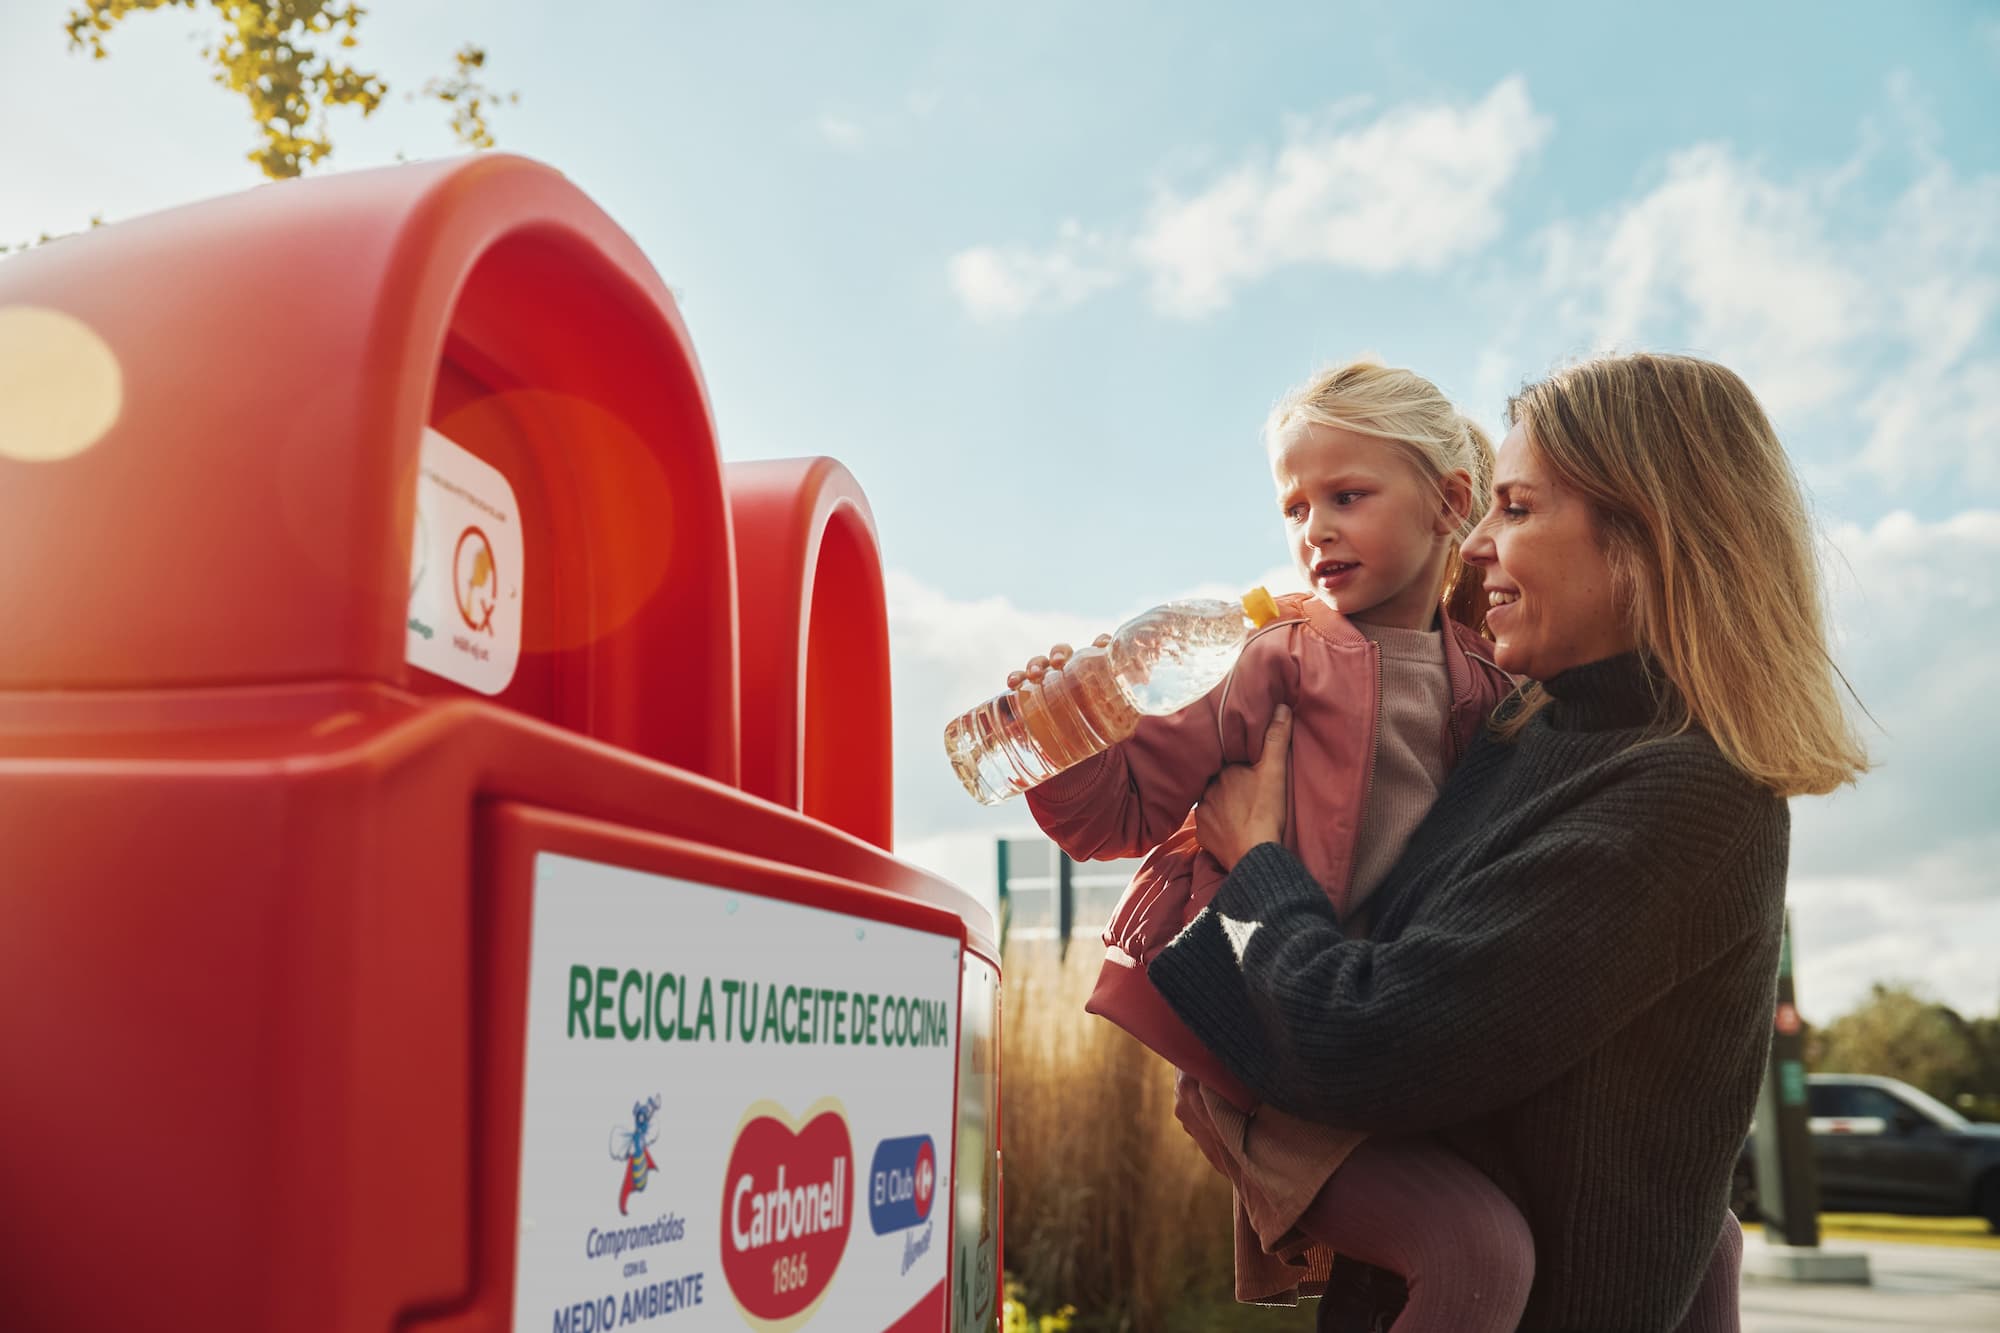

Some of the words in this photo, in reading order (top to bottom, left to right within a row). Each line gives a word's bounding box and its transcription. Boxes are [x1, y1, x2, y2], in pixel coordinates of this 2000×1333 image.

[567, 964, 716, 1042] RECICLA
[721, 979, 759, 1043] TU
[761, 983, 848, 1045] ACEITE
[850, 992, 879, 1046] DE
[881, 995, 949, 1048] COCINA
[731, 1156, 847, 1253] Carbonell
[874, 1171, 886, 1207] El
[888, 1167, 914, 1204] Club
[586, 1211, 686, 1260] Comprometidos
[772, 1252, 808, 1295] 1866
[553, 1295, 617, 1333] MEDIO
[619, 1272, 704, 1327] AMBIENTE
